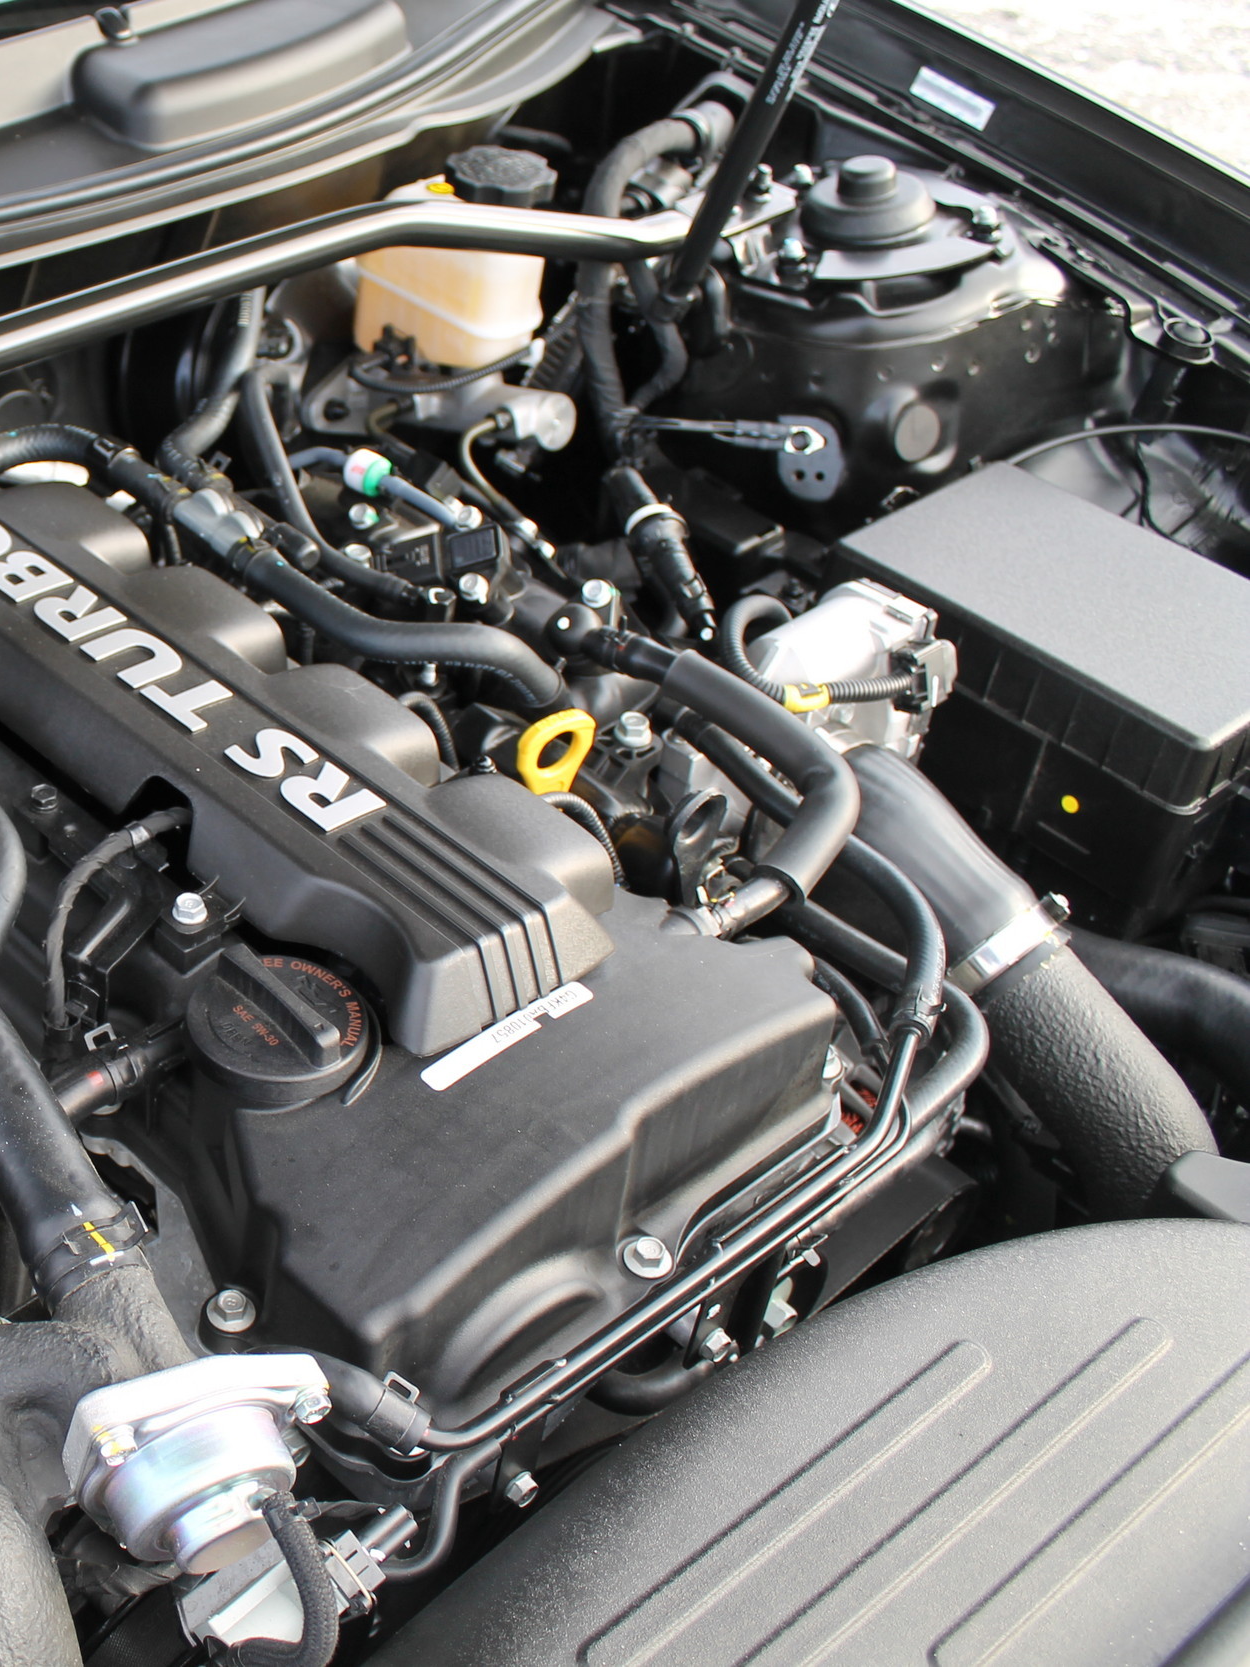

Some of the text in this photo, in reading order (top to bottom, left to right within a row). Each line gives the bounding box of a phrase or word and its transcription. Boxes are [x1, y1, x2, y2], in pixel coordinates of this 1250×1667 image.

[224, 727, 388, 833] RS
[232, 1004, 281, 1047] SAE 5W-30
[262, 957, 363, 1047] EE OWNER'S MANUAL
